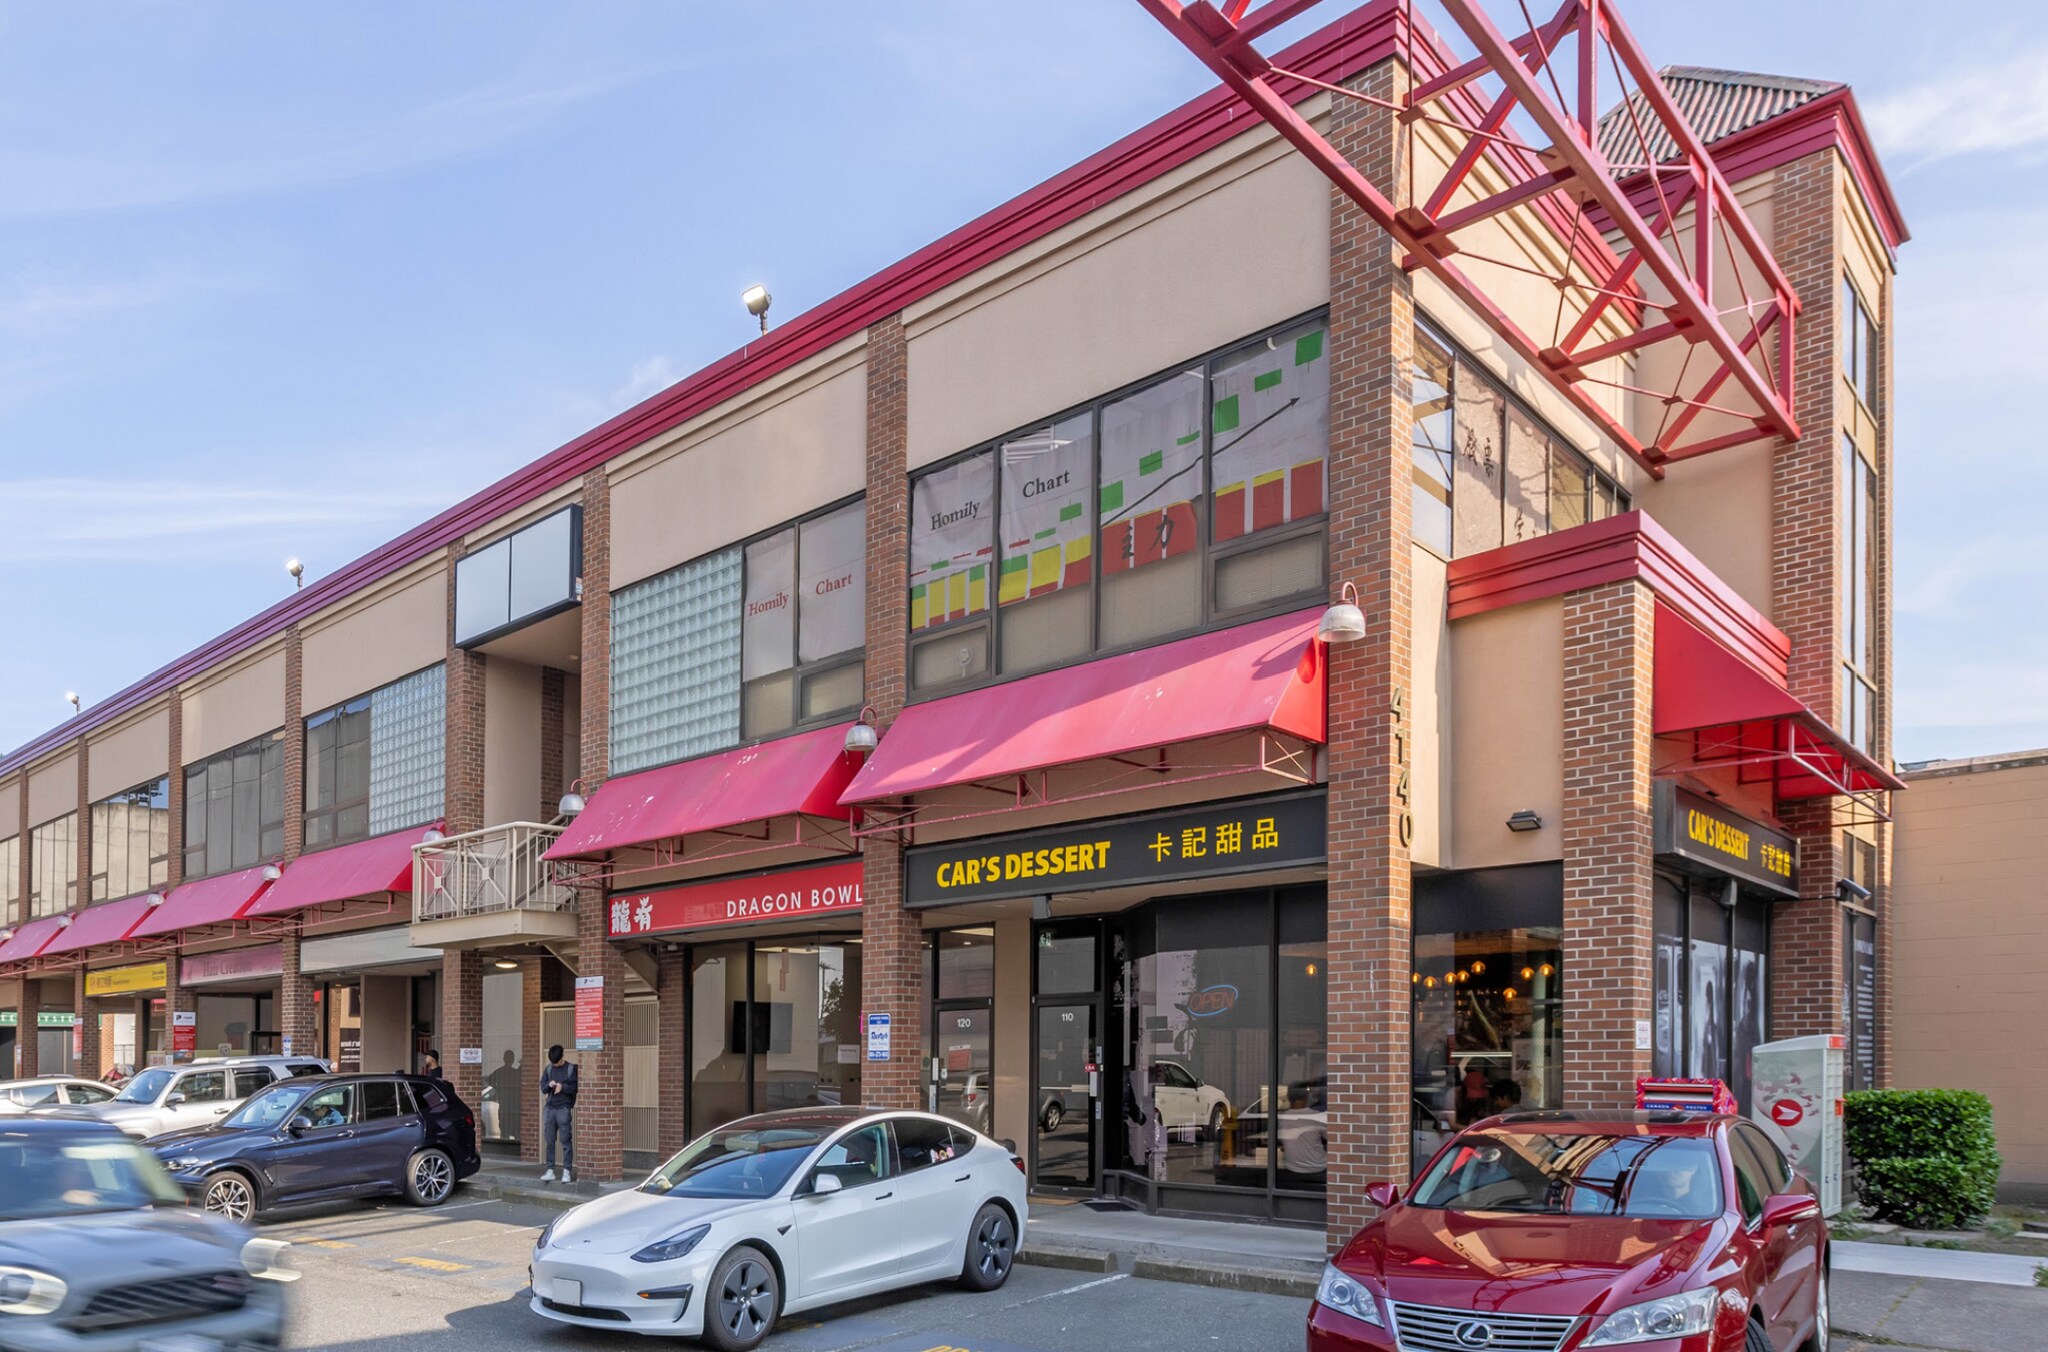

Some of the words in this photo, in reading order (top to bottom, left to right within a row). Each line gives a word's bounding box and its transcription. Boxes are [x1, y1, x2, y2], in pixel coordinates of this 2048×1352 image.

[930, 500, 980, 531] Homily
[1022, 470, 1070, 498] Chart
[748, 592, 789, 617] Homily
[815, 573, 852, 595] Chart
[1391, 685, 1414, 848] 4140
[1148, 817, 1279, 863] 卡記甜品
[1688, 808, 1715, 847] CAR'S
[1715, 820, 1750, 861] DESSERT
[936, 856, 1001, 889] CAR'S
[1005, 840, 1111, 881] DESSERT
[727, 891, 801, 918] DRAGON
[811, 884, 862, 908] BOWL
[957, 1018, 971, 1028] 120
[1061, 1012, 1074, 1022] 110
[1190, 990, 1235, 1011] OPEN
